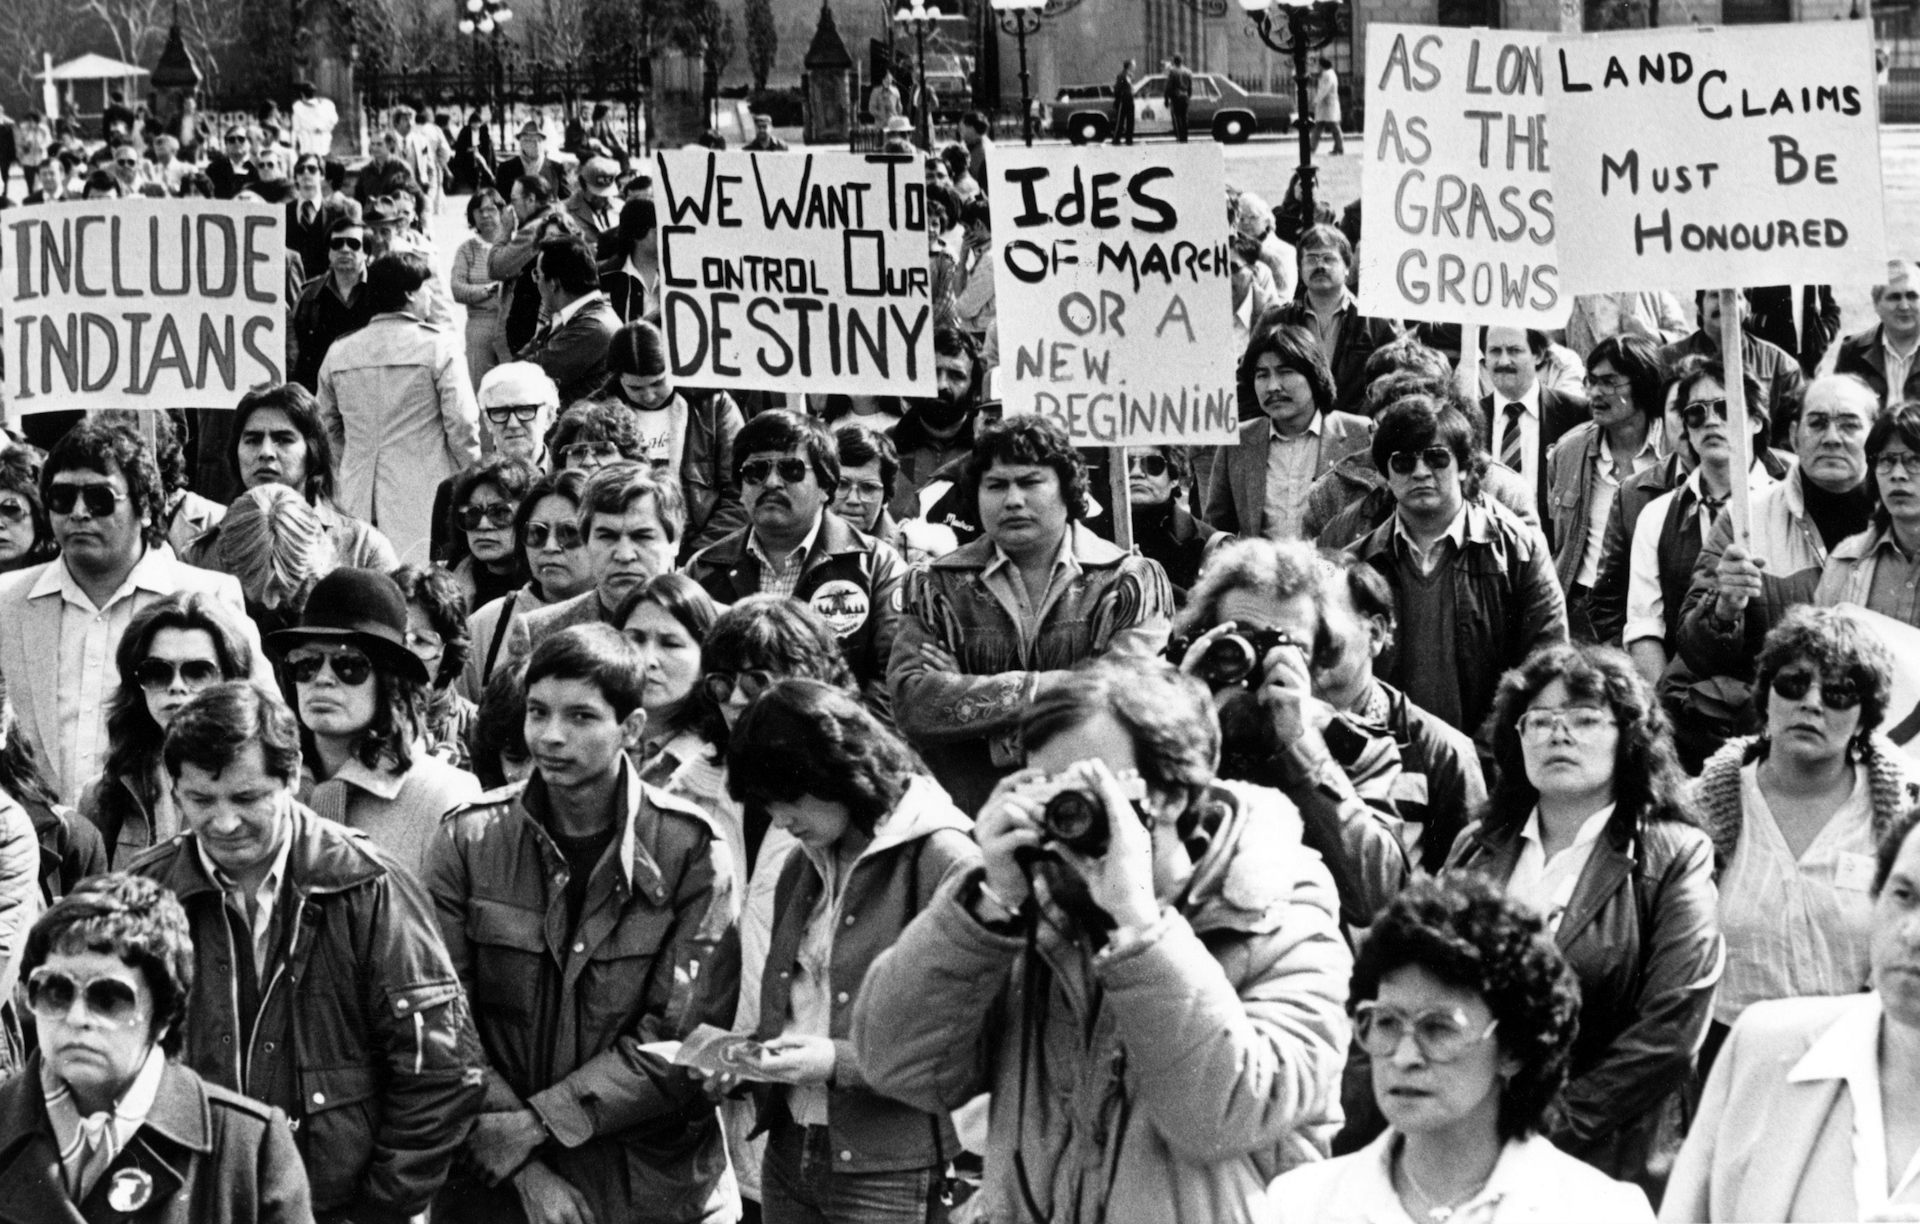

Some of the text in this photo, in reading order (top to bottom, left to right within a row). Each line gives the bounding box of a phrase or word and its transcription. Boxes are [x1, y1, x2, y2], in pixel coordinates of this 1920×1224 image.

[1378, 33, 1443, 92] AS
[1558, 48, 1862, 120] LAND CLAIMS
[1377, 109, 1551, 173] AS THE
[1601, 135, 1839, 197] MUST BE
[657, 151, 926, 232] WE WANT TO
[1395, 168, 1555, 246] GRASS
[8, 213, 278, 304] INCLUDE
[662, 225, 929, 298] CONTROL OUR
[1634, 208, 1849, 257] HONOURED
[1004, 239, 1229, 295] OF MARCH
[1396, 247, 1559, 312] GROWS
[665, 290, 930, 382] DESTINY
[1058, 288, 1197, 344] OR A
[14, 312, 282, 400] INDIANS
